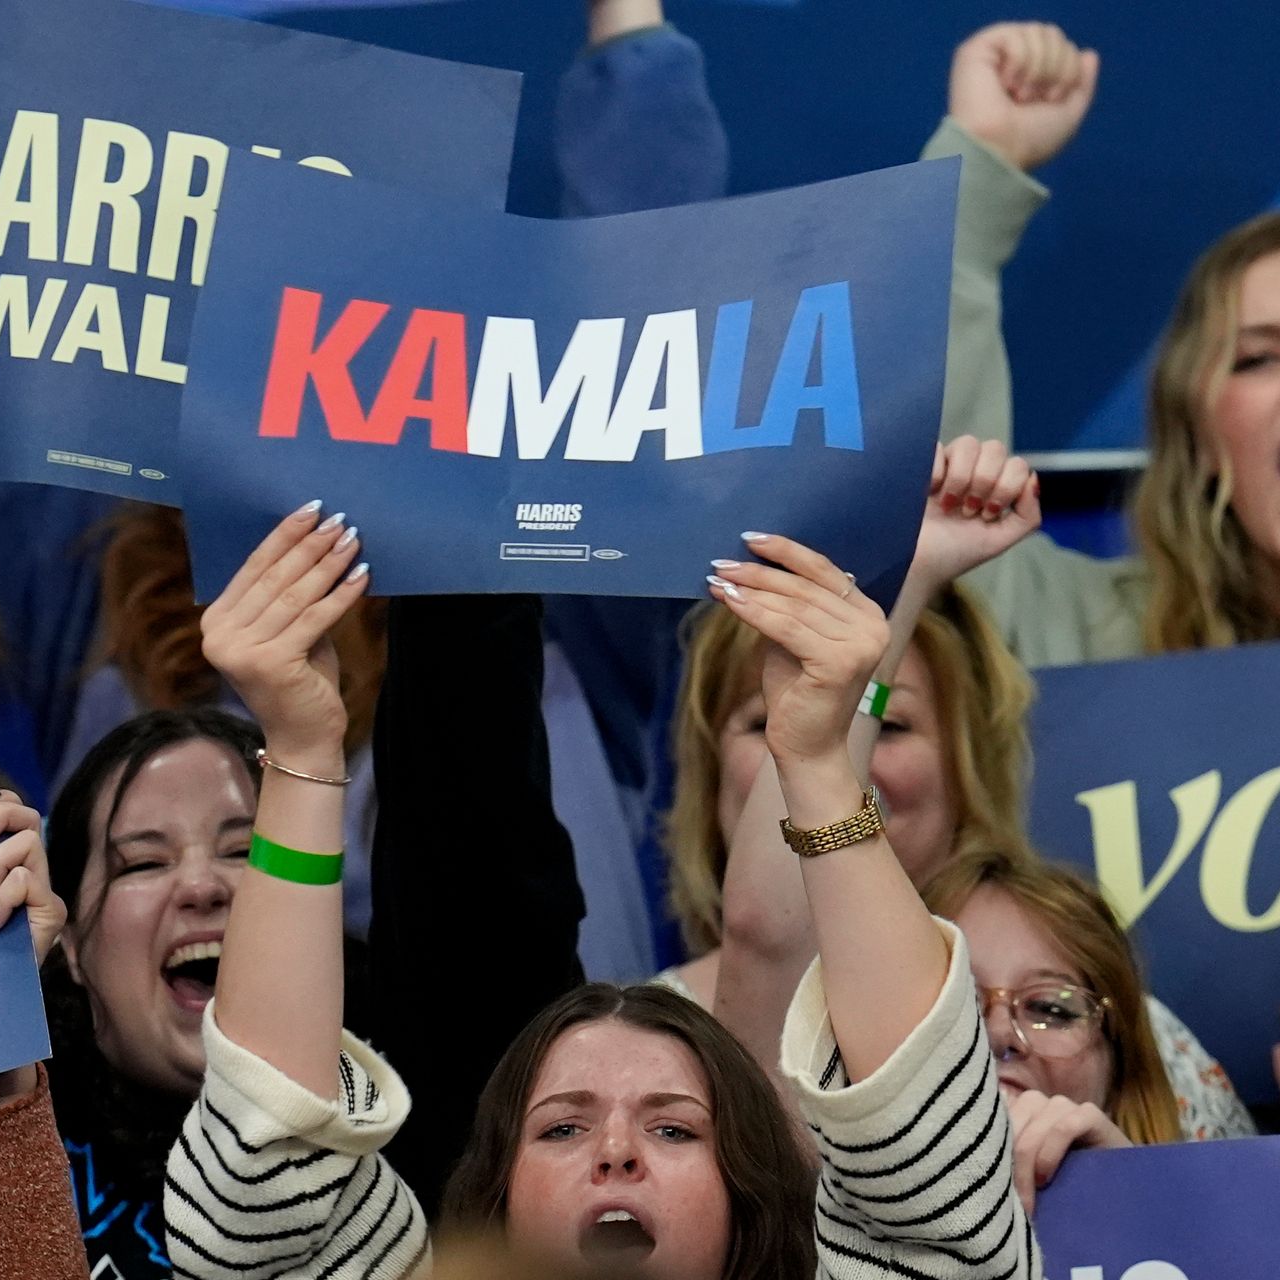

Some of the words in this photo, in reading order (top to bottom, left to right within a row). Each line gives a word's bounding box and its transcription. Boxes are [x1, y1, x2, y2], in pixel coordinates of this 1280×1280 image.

[257, 280, 865, 462] KAMALA
[516, 503, 583, 522] HARRIS
[518, 521, 577, 531] PRESIDENT
